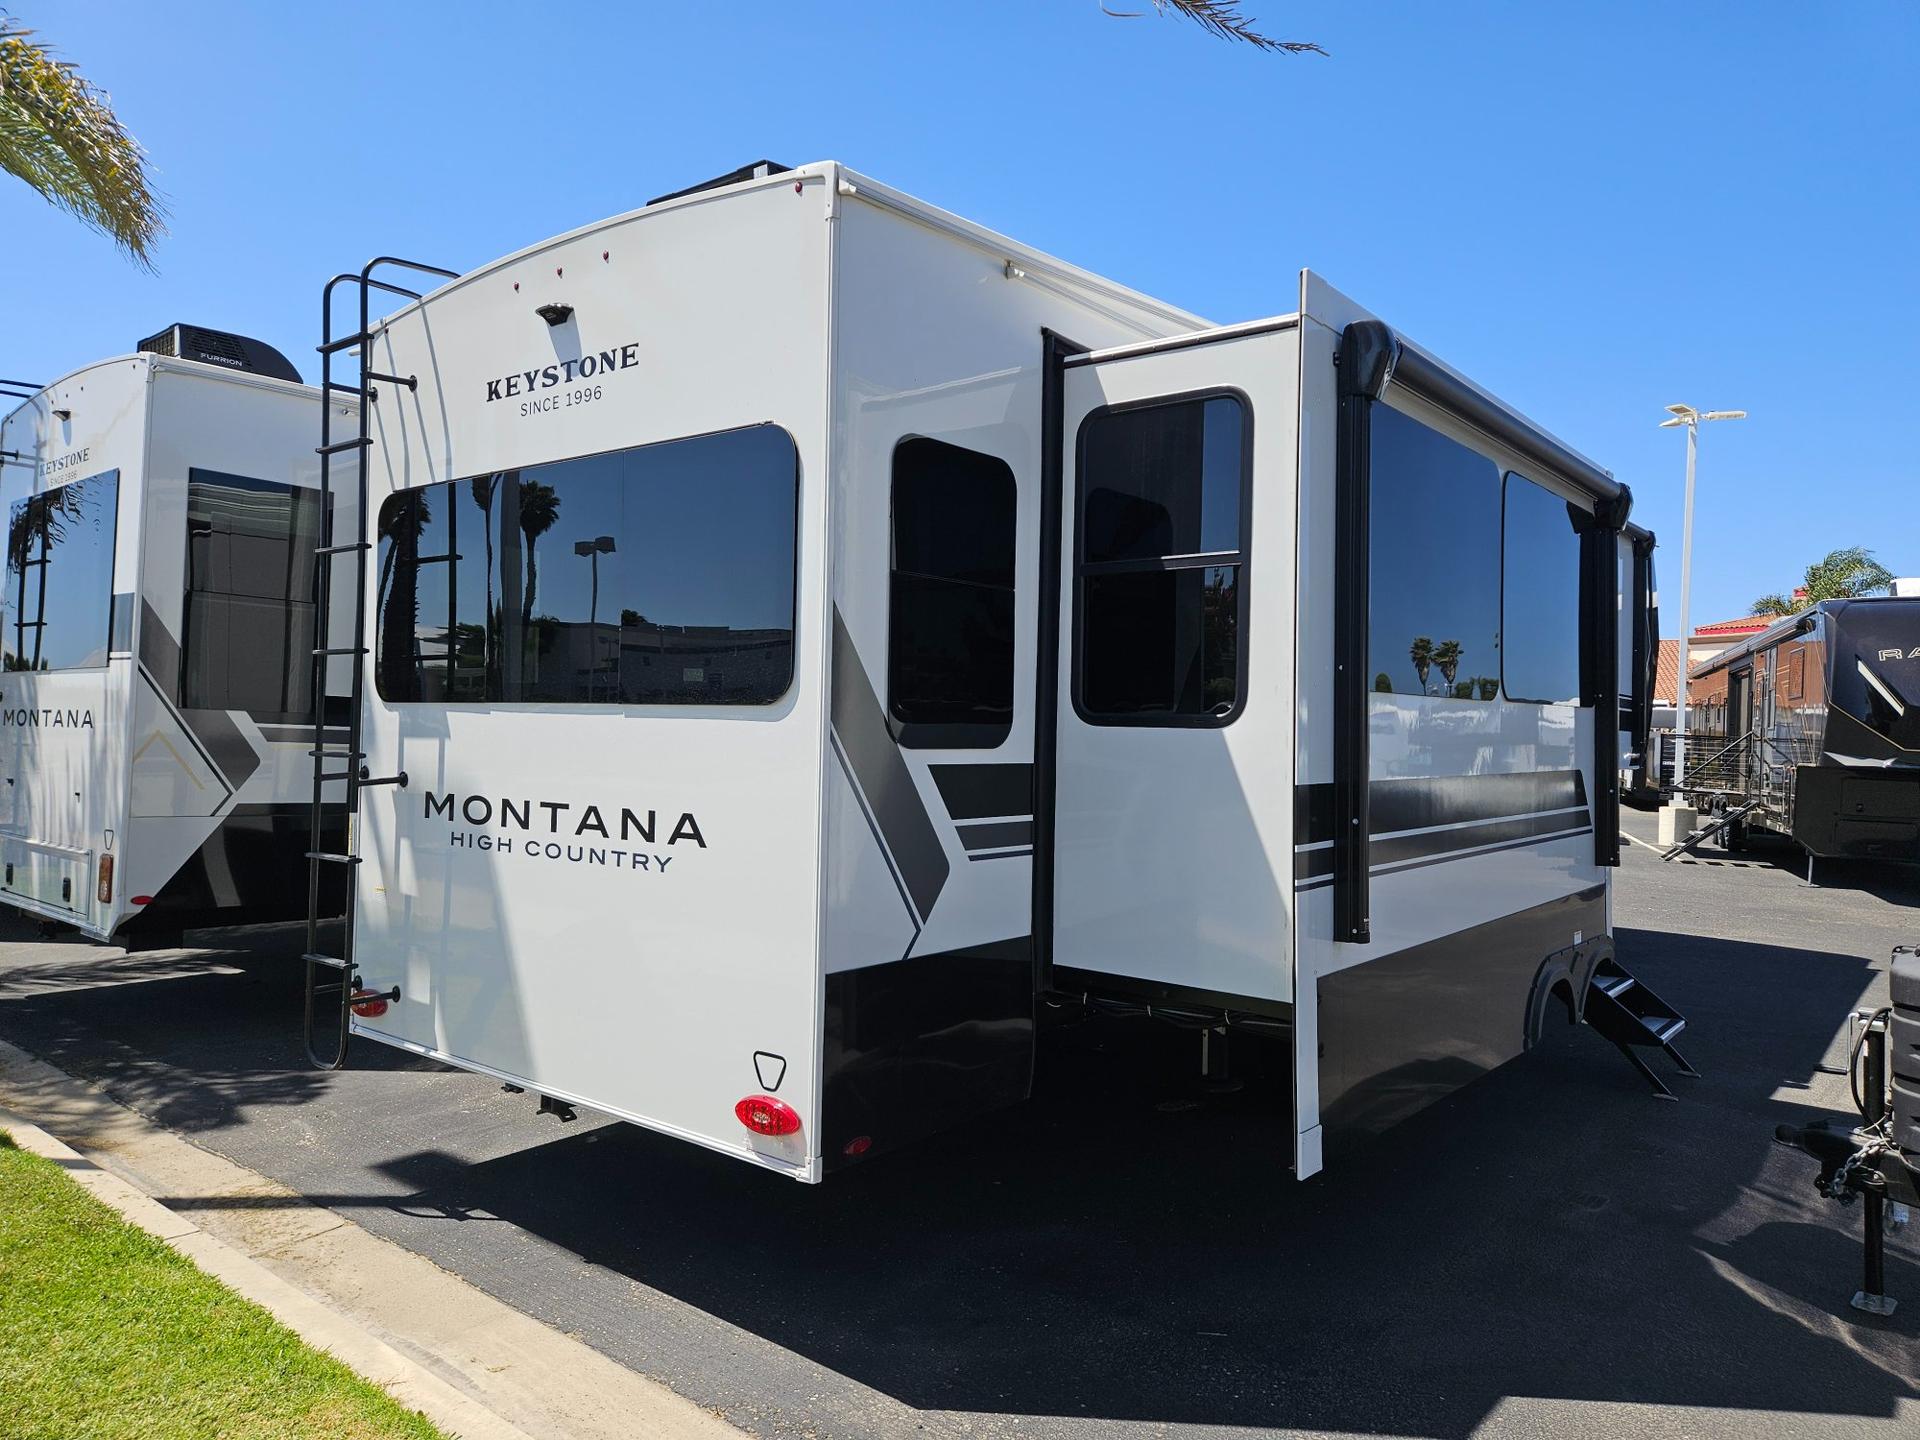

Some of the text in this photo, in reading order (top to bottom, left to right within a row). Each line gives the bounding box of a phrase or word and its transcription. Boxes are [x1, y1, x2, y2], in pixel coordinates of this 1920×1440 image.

[200, 352, 243, 367] FURRION
[485, 343, 640, 403] KEYSTONE
[520, 385, 602, 417] SINCE 1996
[39, 447, 90, 477] KEYSTONE
[2, 708, 94, 729] MONTANA
[424, 791, 708, 849] MONTANA
[450, 831, 673, 873] HIGH COUNTRY
